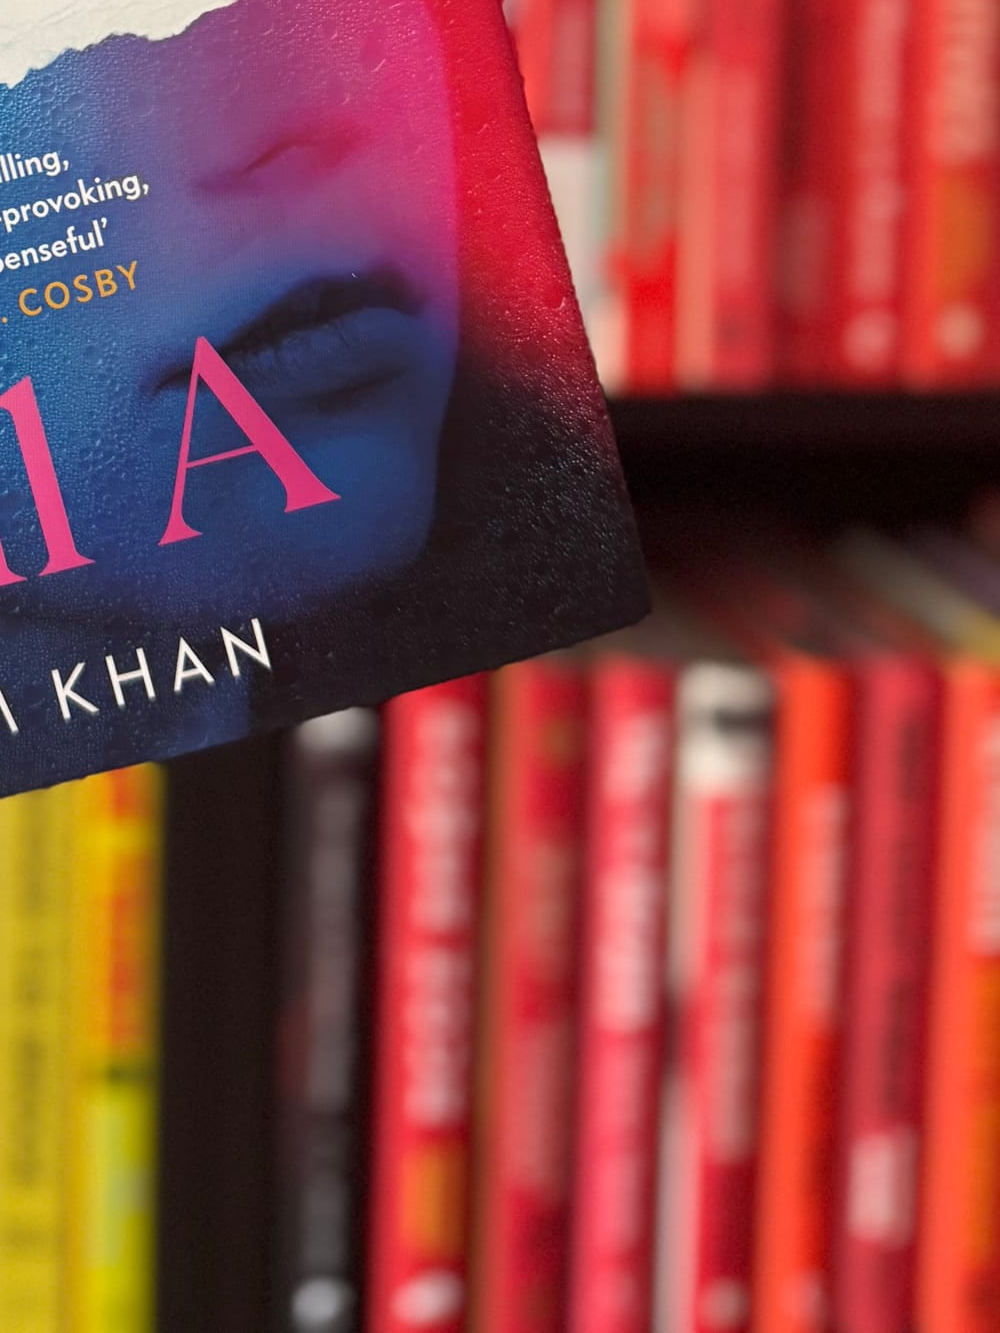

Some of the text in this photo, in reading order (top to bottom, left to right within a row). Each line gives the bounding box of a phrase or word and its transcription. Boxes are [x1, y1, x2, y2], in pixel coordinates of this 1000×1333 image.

[18, 260, 139, 317] COSBY
[158, 335, 343, 547] A
[50, 617, 274, 722] KHAN
